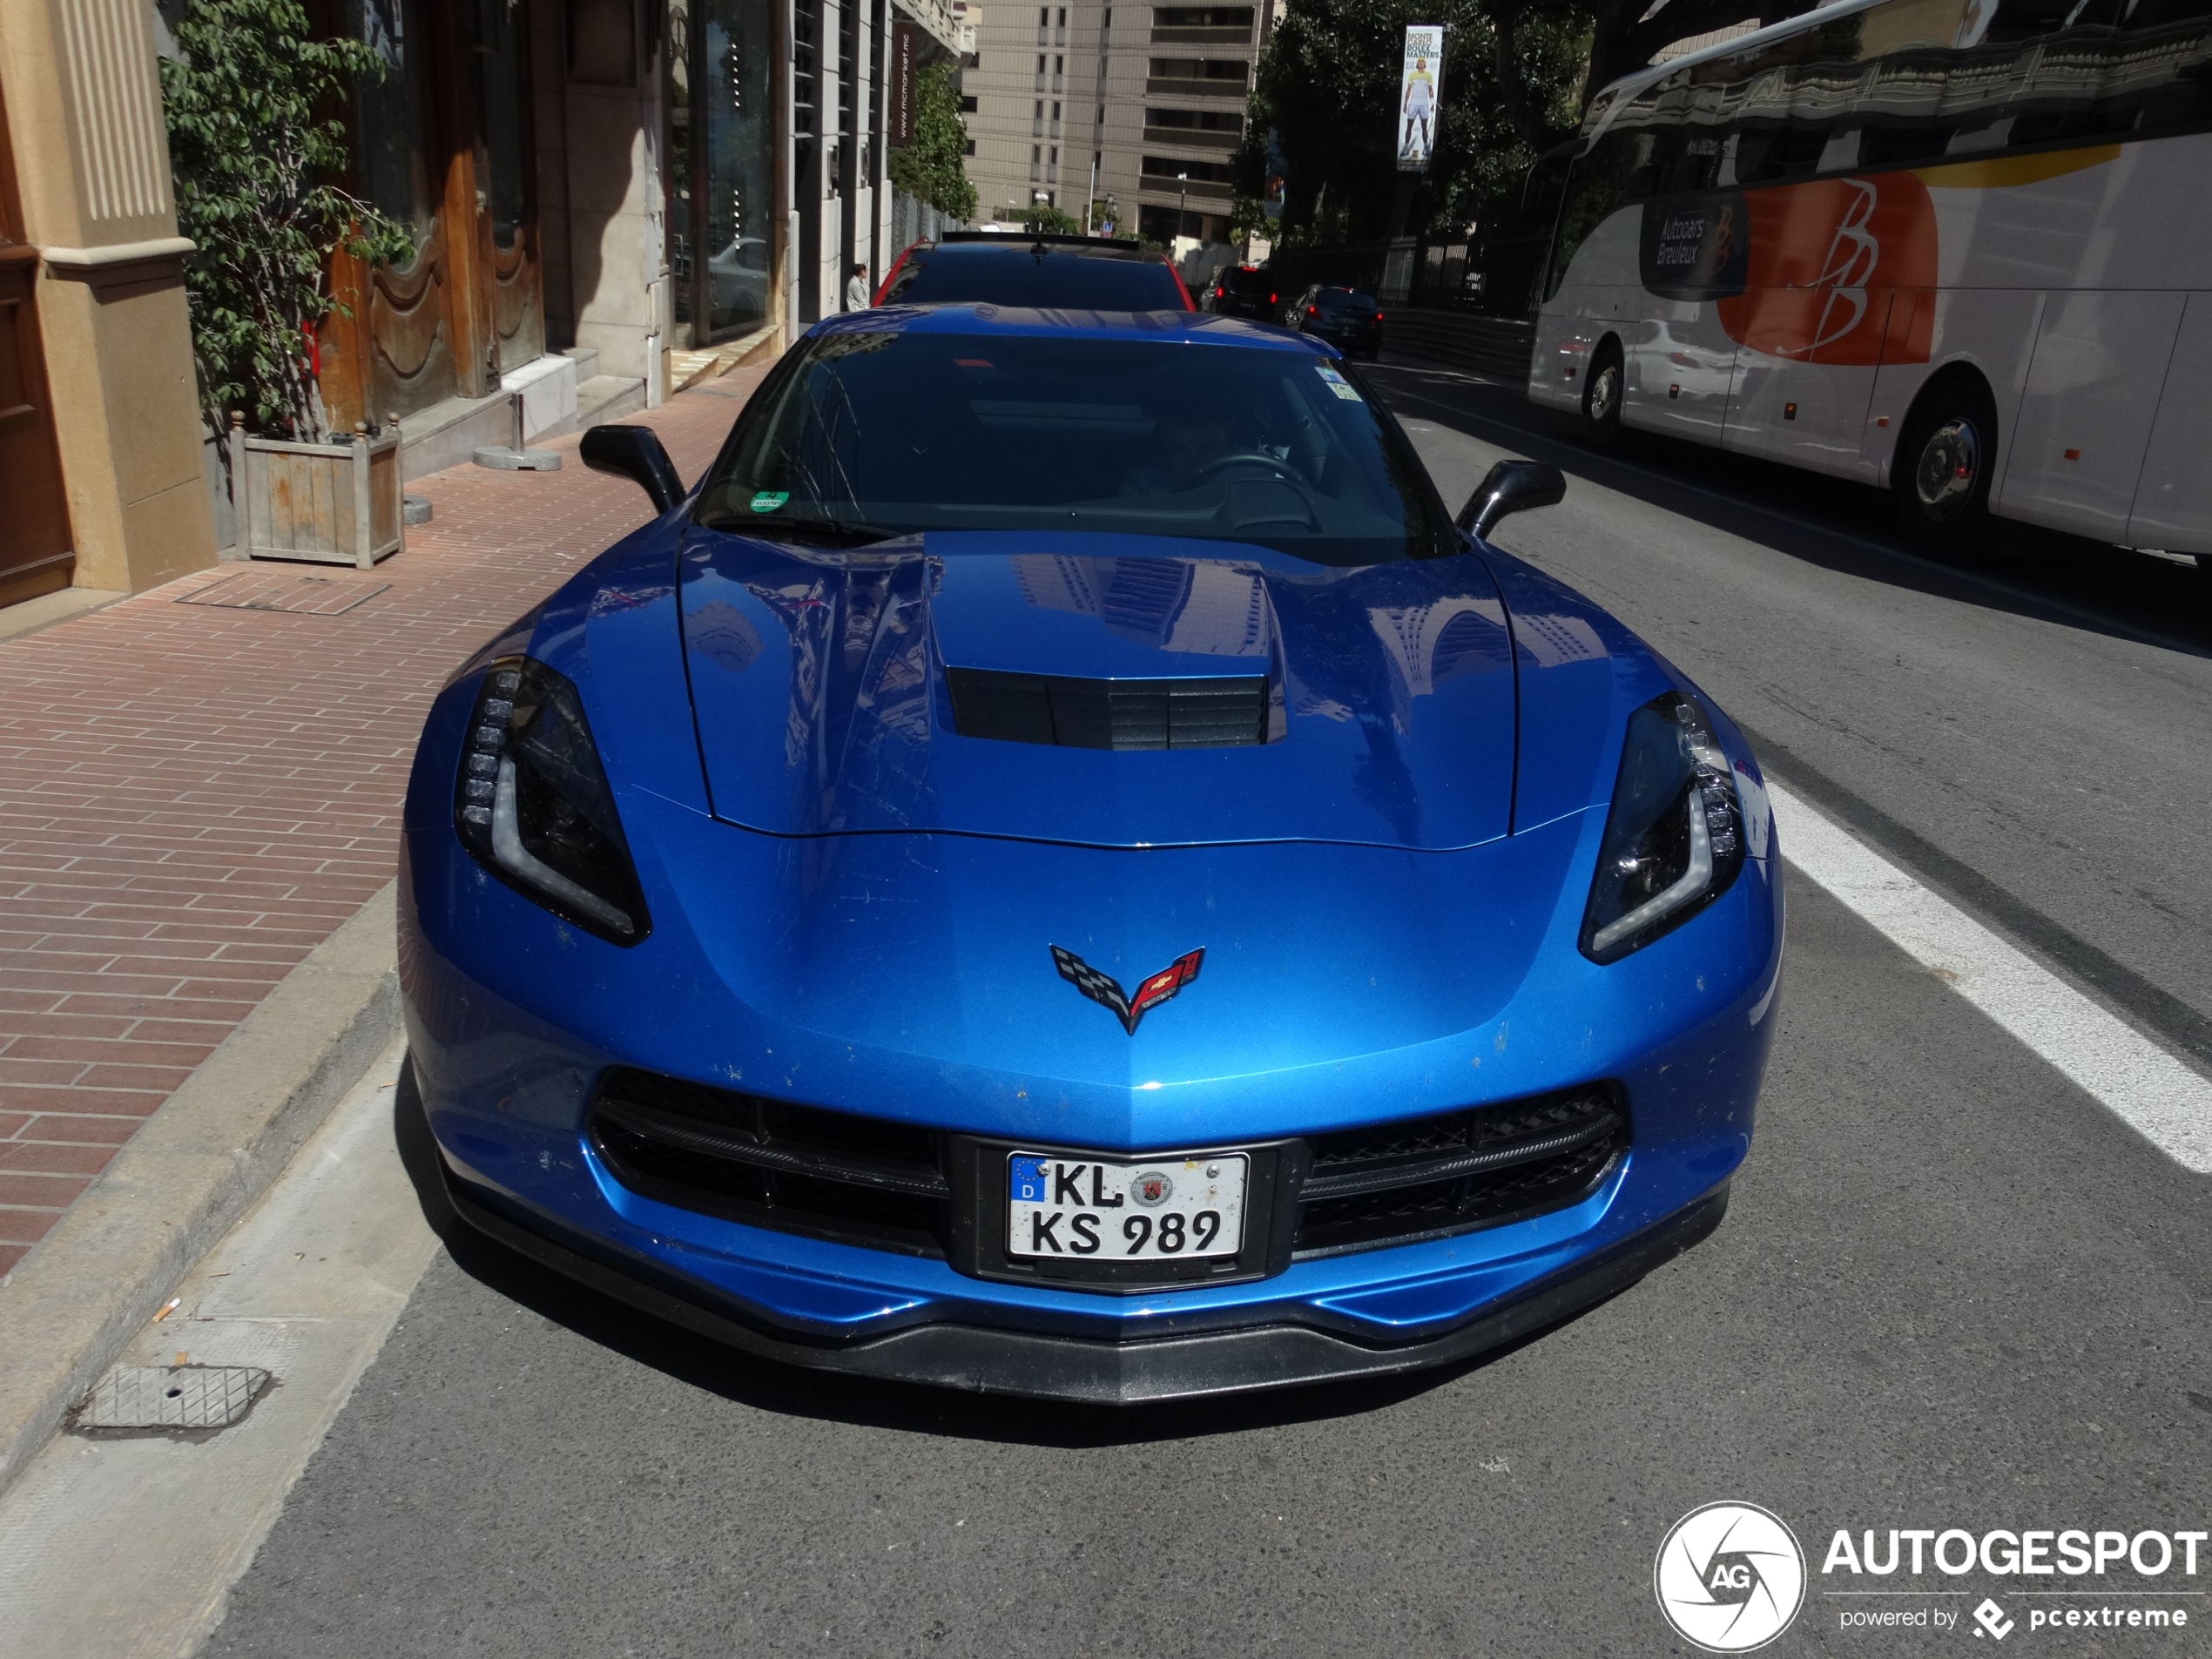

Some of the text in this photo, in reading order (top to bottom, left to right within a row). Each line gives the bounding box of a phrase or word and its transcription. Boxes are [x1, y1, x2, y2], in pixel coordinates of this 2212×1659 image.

[900, 33, 909, 138] www.mcmarket.mc
[1660, 217, 1704, 240] Autocars
[1656, 241, 1698, 265] Breuleux
[1022, 1184, 1034, 1198] D
[1055, 1163, 1124, 1208] KL
[1032, 1210, 1221, 1255] KS 989
